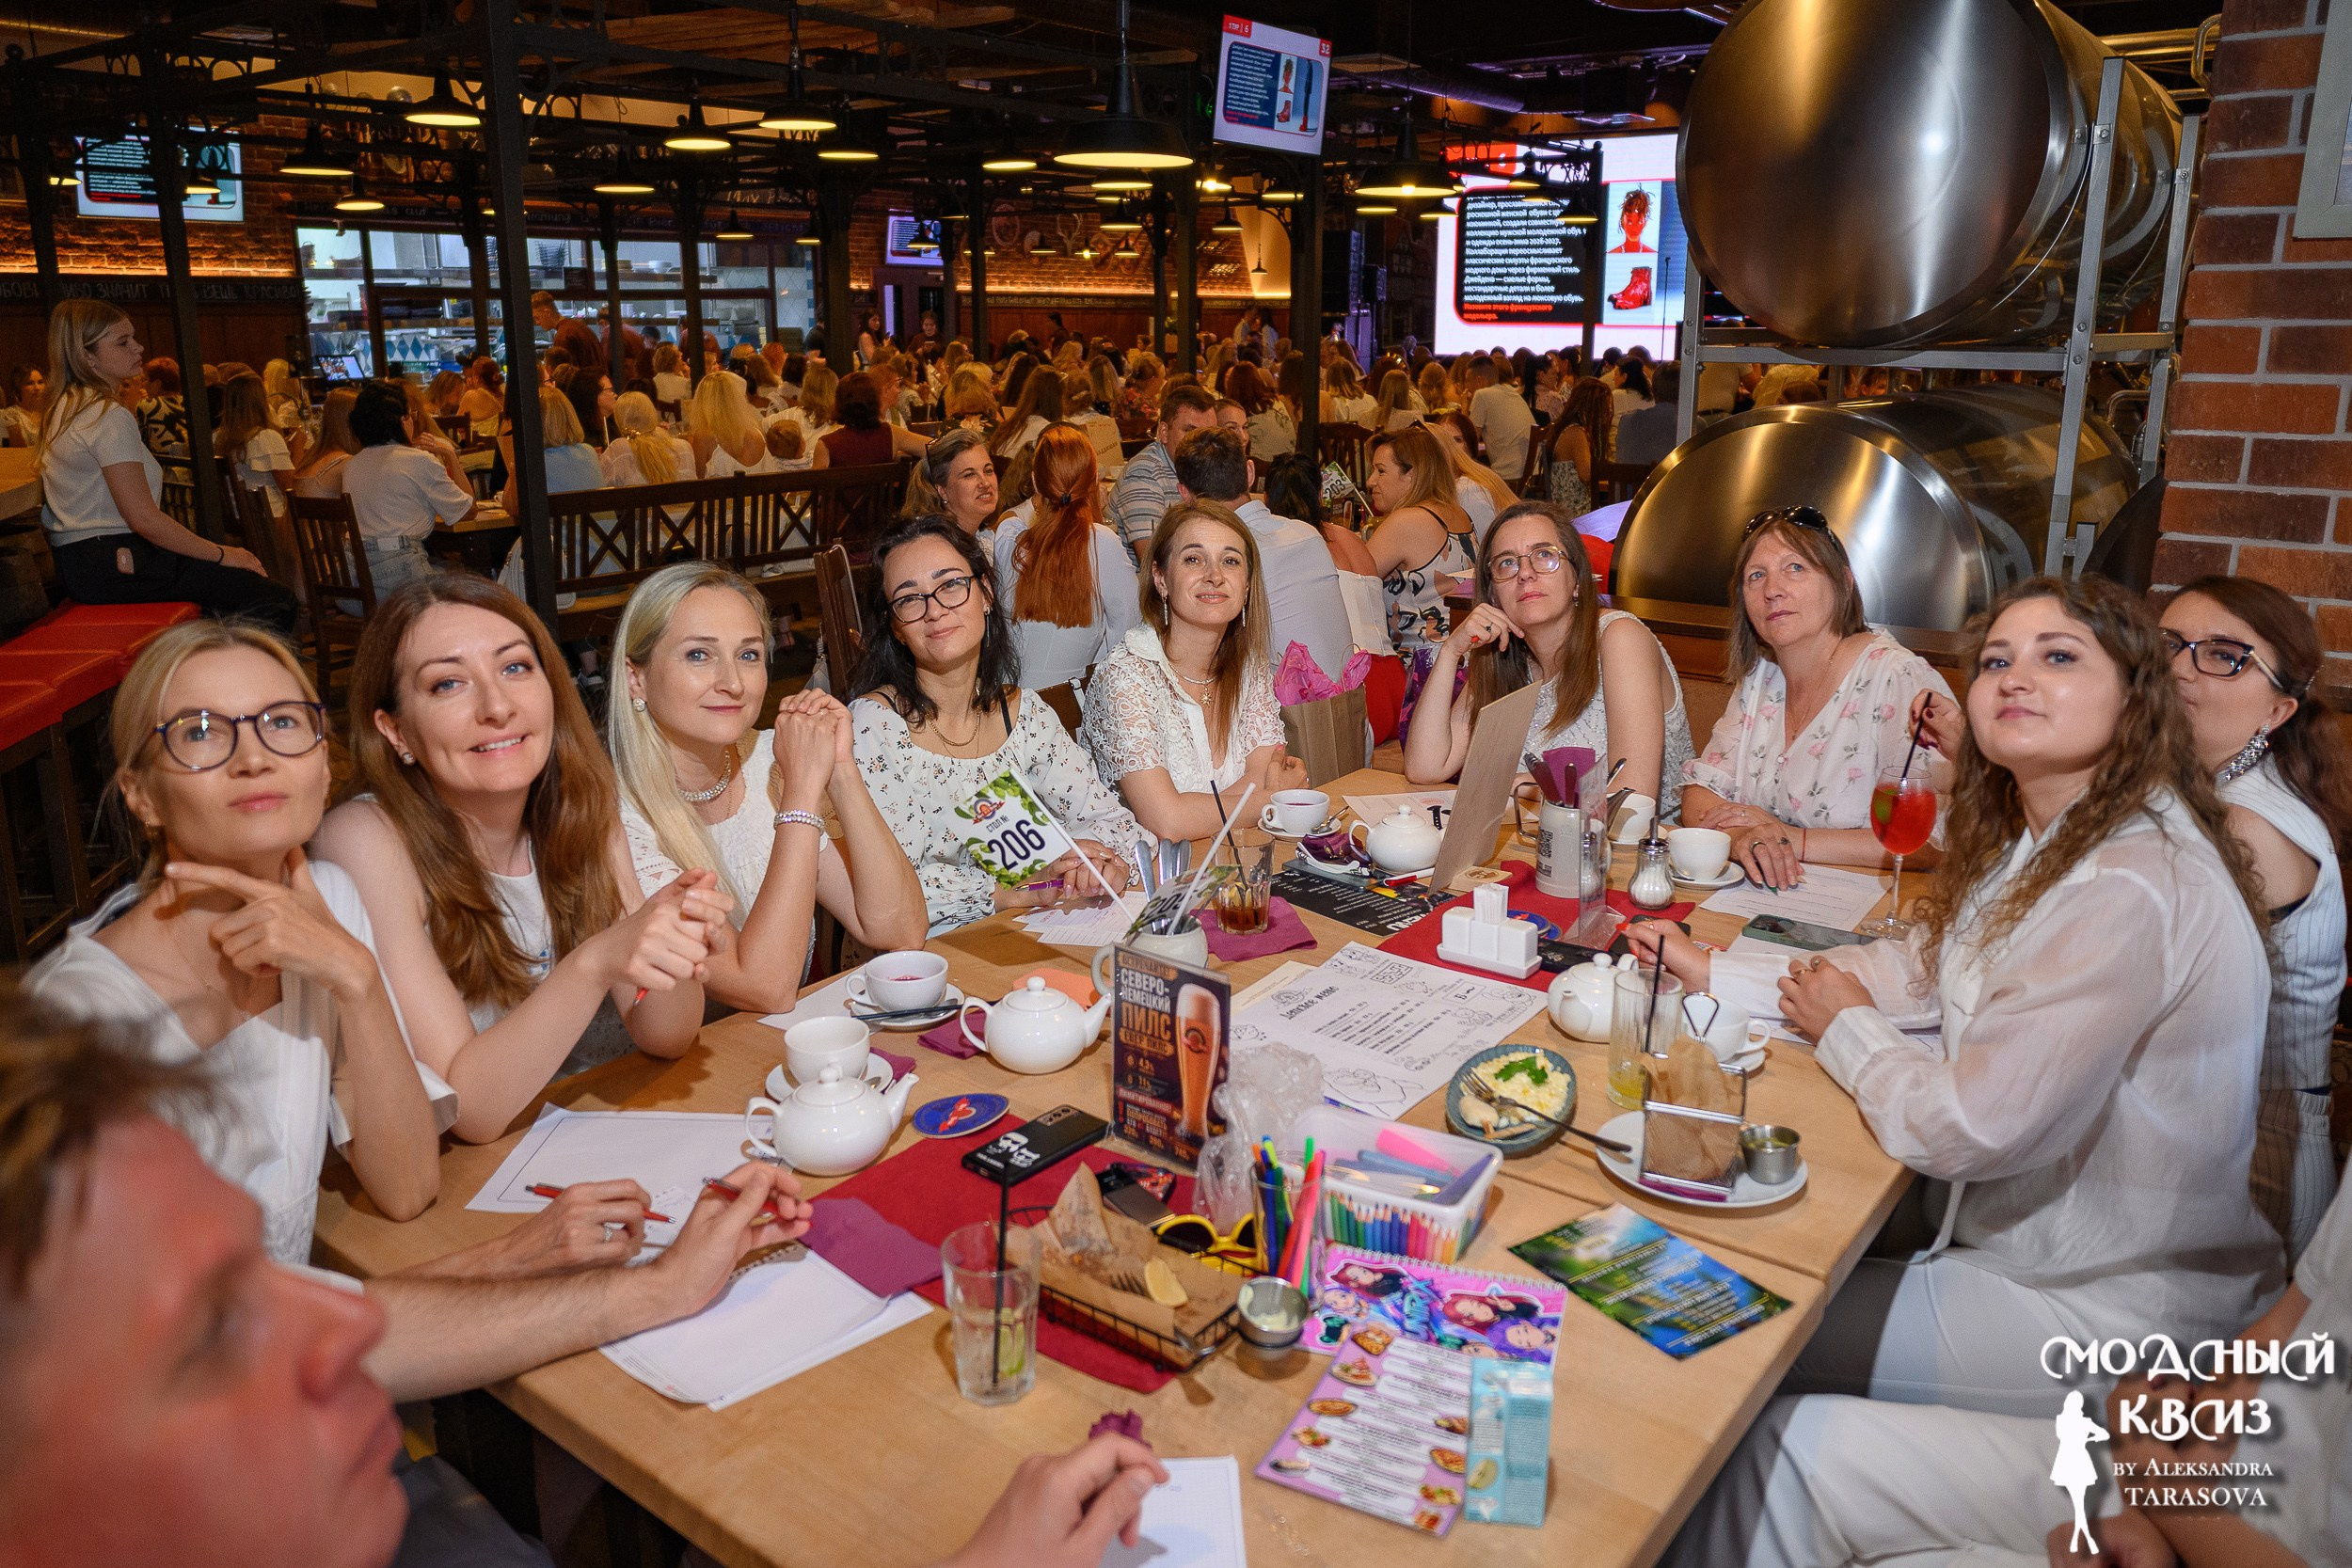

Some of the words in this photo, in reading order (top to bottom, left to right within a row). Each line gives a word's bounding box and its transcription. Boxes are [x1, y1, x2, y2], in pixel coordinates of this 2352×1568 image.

[1500, 229, 1526, 237] мужской
[1465, 247, 1508, 256] Коллаборация
[1505, 257, 1529, 265] силуэты
[1530, 256, 1572, 265] французского
[1525, 265, 1562, 275] фирменный
[1510, 303, 1553, 312] французского
[1325, 479, 1346, 499] 203
[986, 818, 1002, 833] СТОЛ
[987, 819, 1045, 871] 206
[1120, 967, 1169, 995] СЕВЕРО-
[1121, 985, 1171, 1014] НЕМЕЦКИЙ
[1121, 1002, 1171, 1040] ПИЛС
